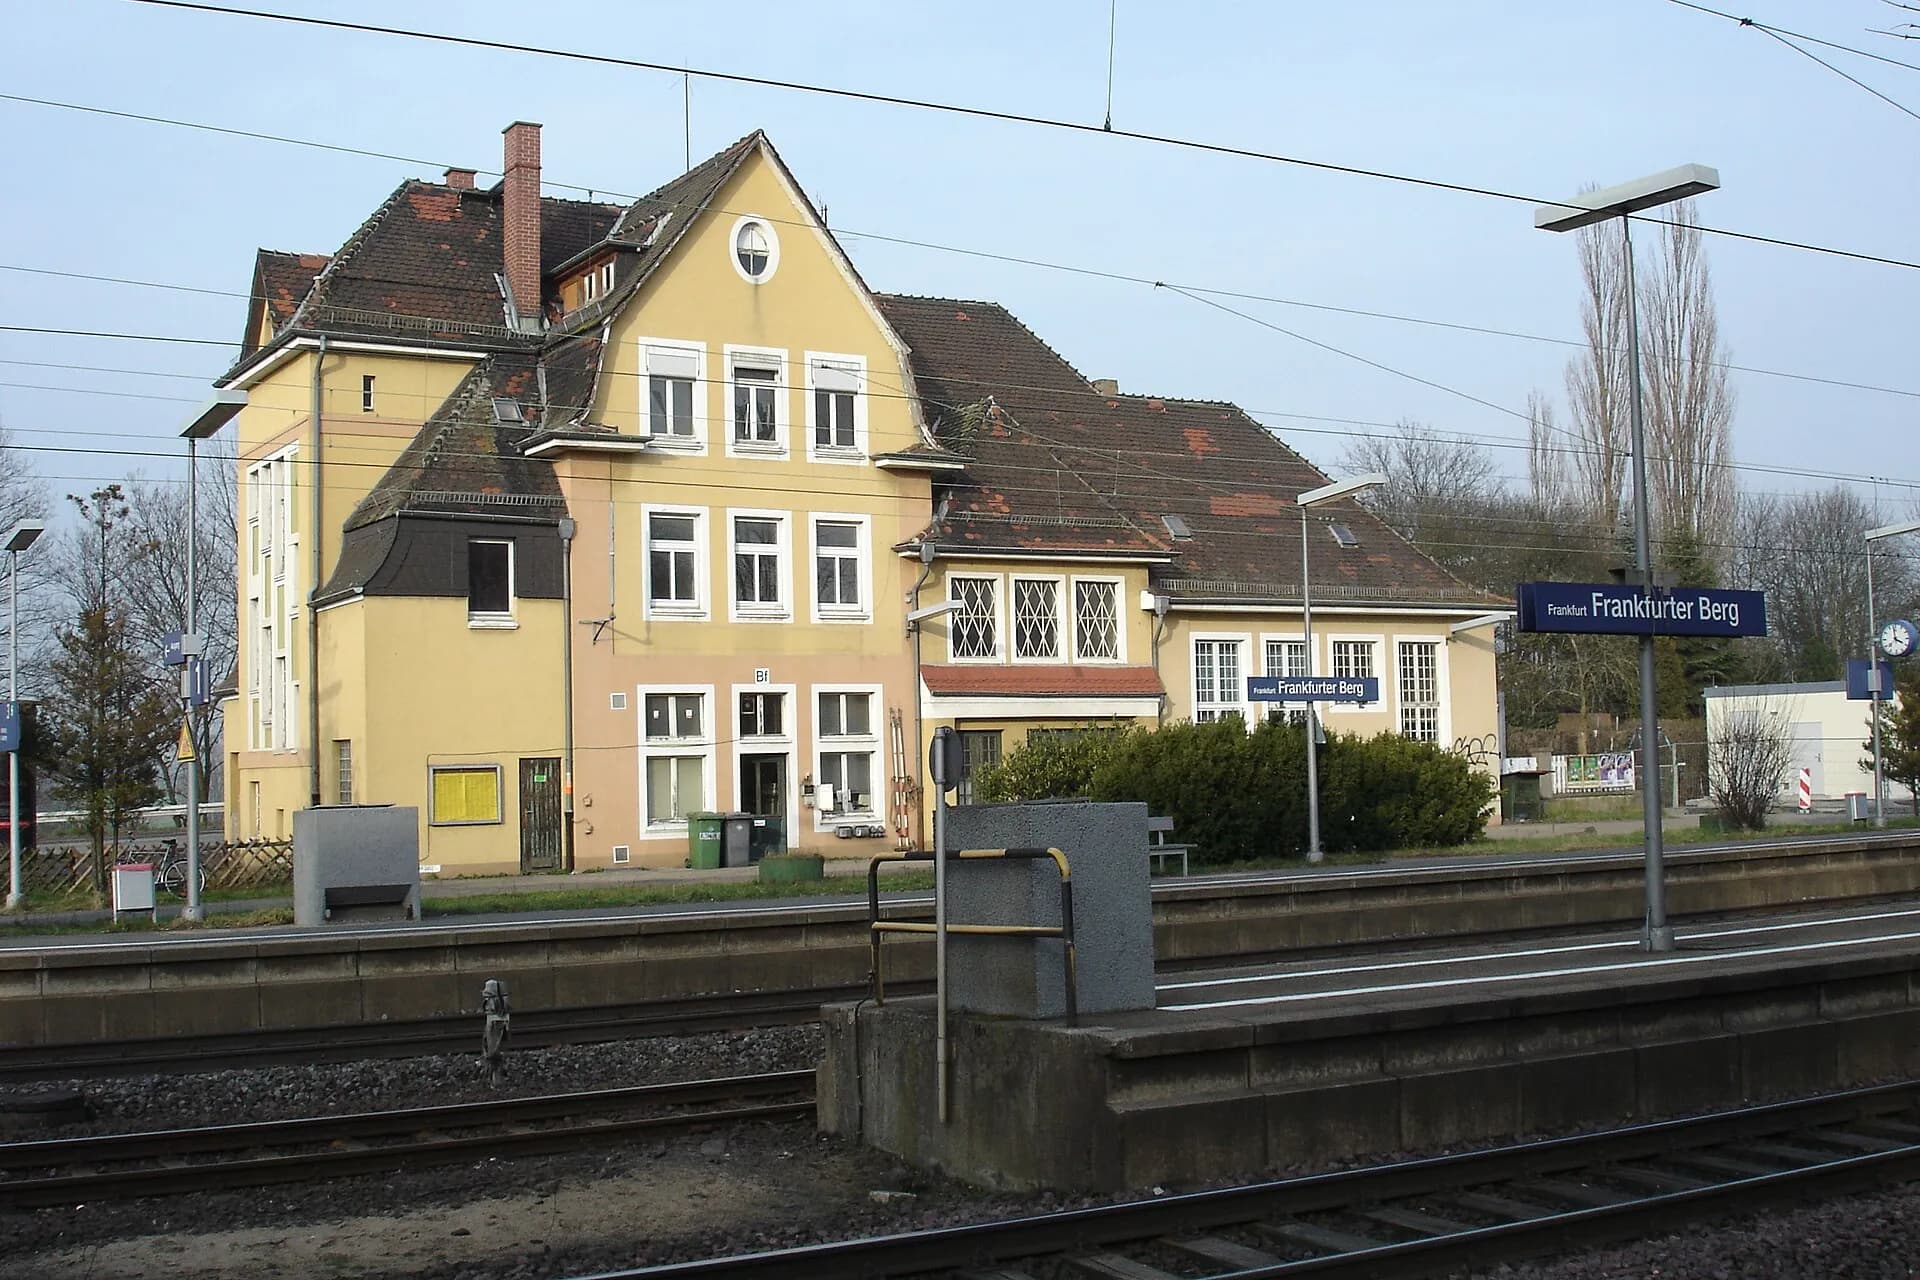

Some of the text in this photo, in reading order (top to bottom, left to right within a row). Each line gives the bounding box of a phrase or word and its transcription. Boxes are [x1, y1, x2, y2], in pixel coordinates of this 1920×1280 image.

[1548, 592, 1740, 627] Frankfurt Frankfurter Berg
[756, 670, 768, 682] Bf
[1278, 681, 1337, 695] Frankfurter
[1339, 681, 1364, 697] Berg
